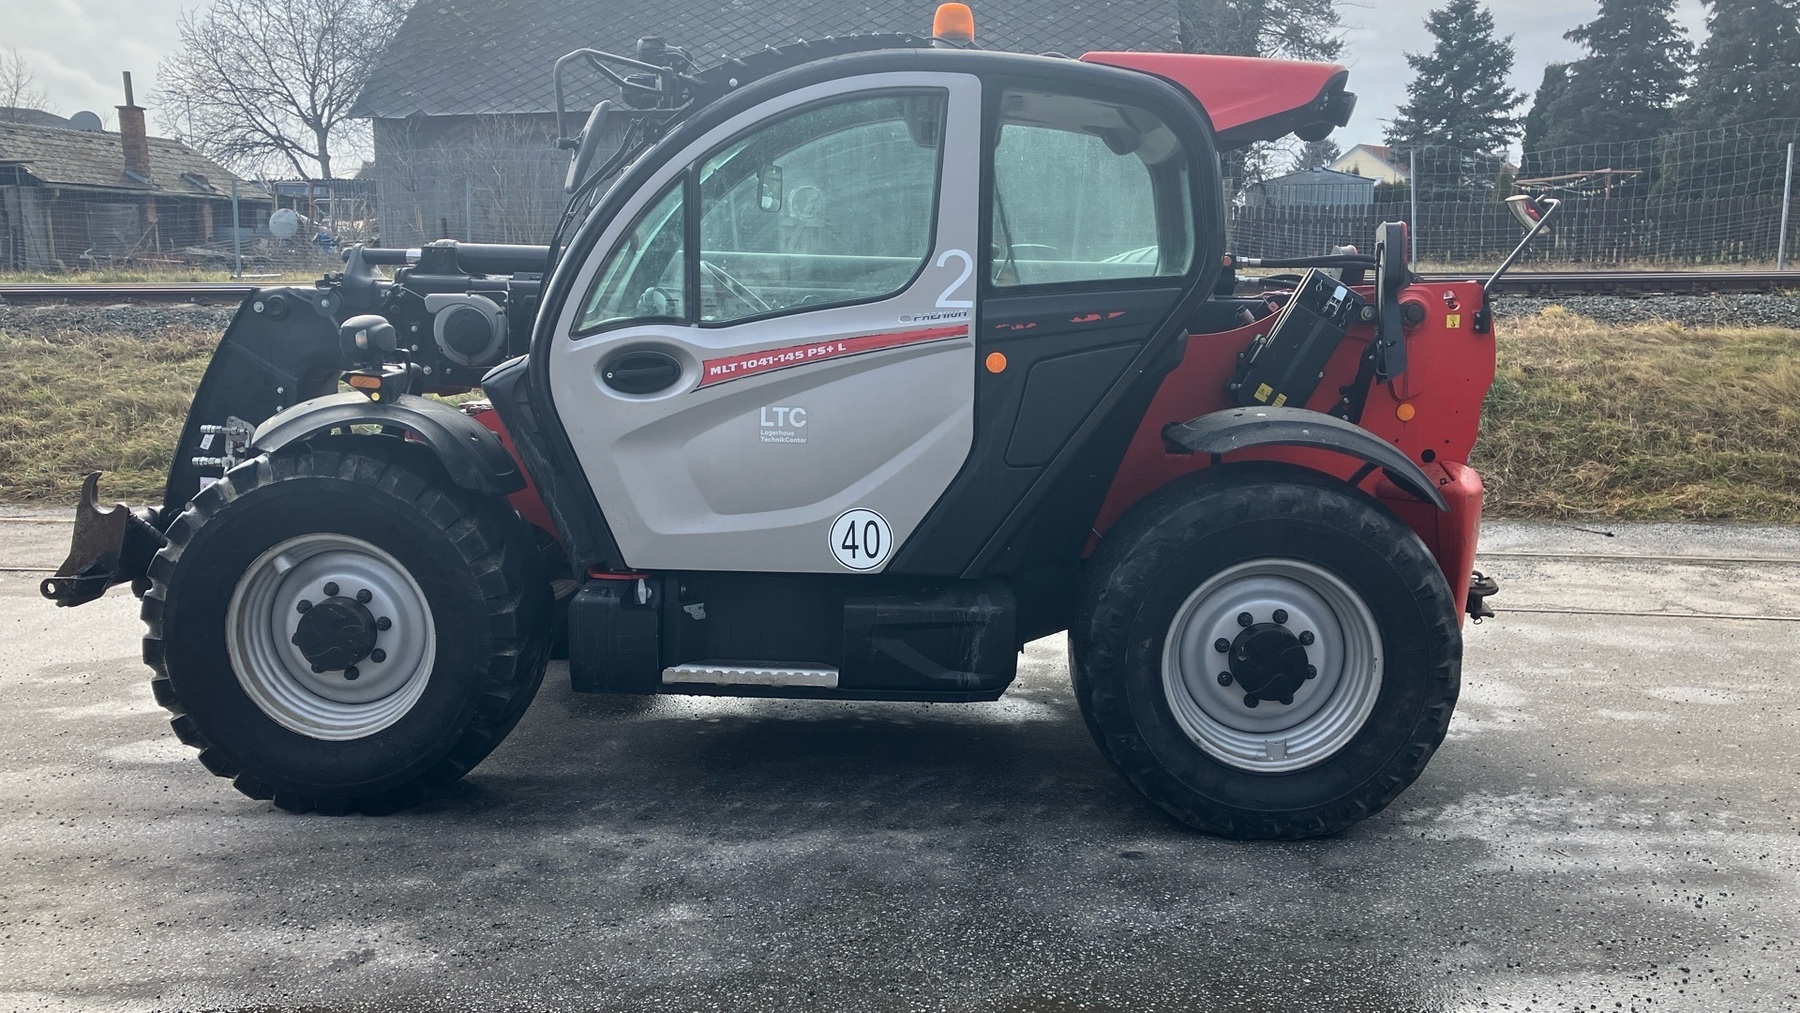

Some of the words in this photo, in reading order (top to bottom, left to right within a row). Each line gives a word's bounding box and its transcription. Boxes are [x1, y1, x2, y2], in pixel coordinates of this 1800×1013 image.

[935, 249, 973, 308] 2
[914, 309, 967, 322] PREMIUM
[710, 363, 738, 375] MLT
[740, 350, 805, 369] 1041-145
[808, 345, 834, 357] PS+
[837, 343, 846, 351] L
[761, 406, 807, 428] LTC
[760, 429, 795, 437] Lagerhaus
[842, 520, 880, 559] 40
